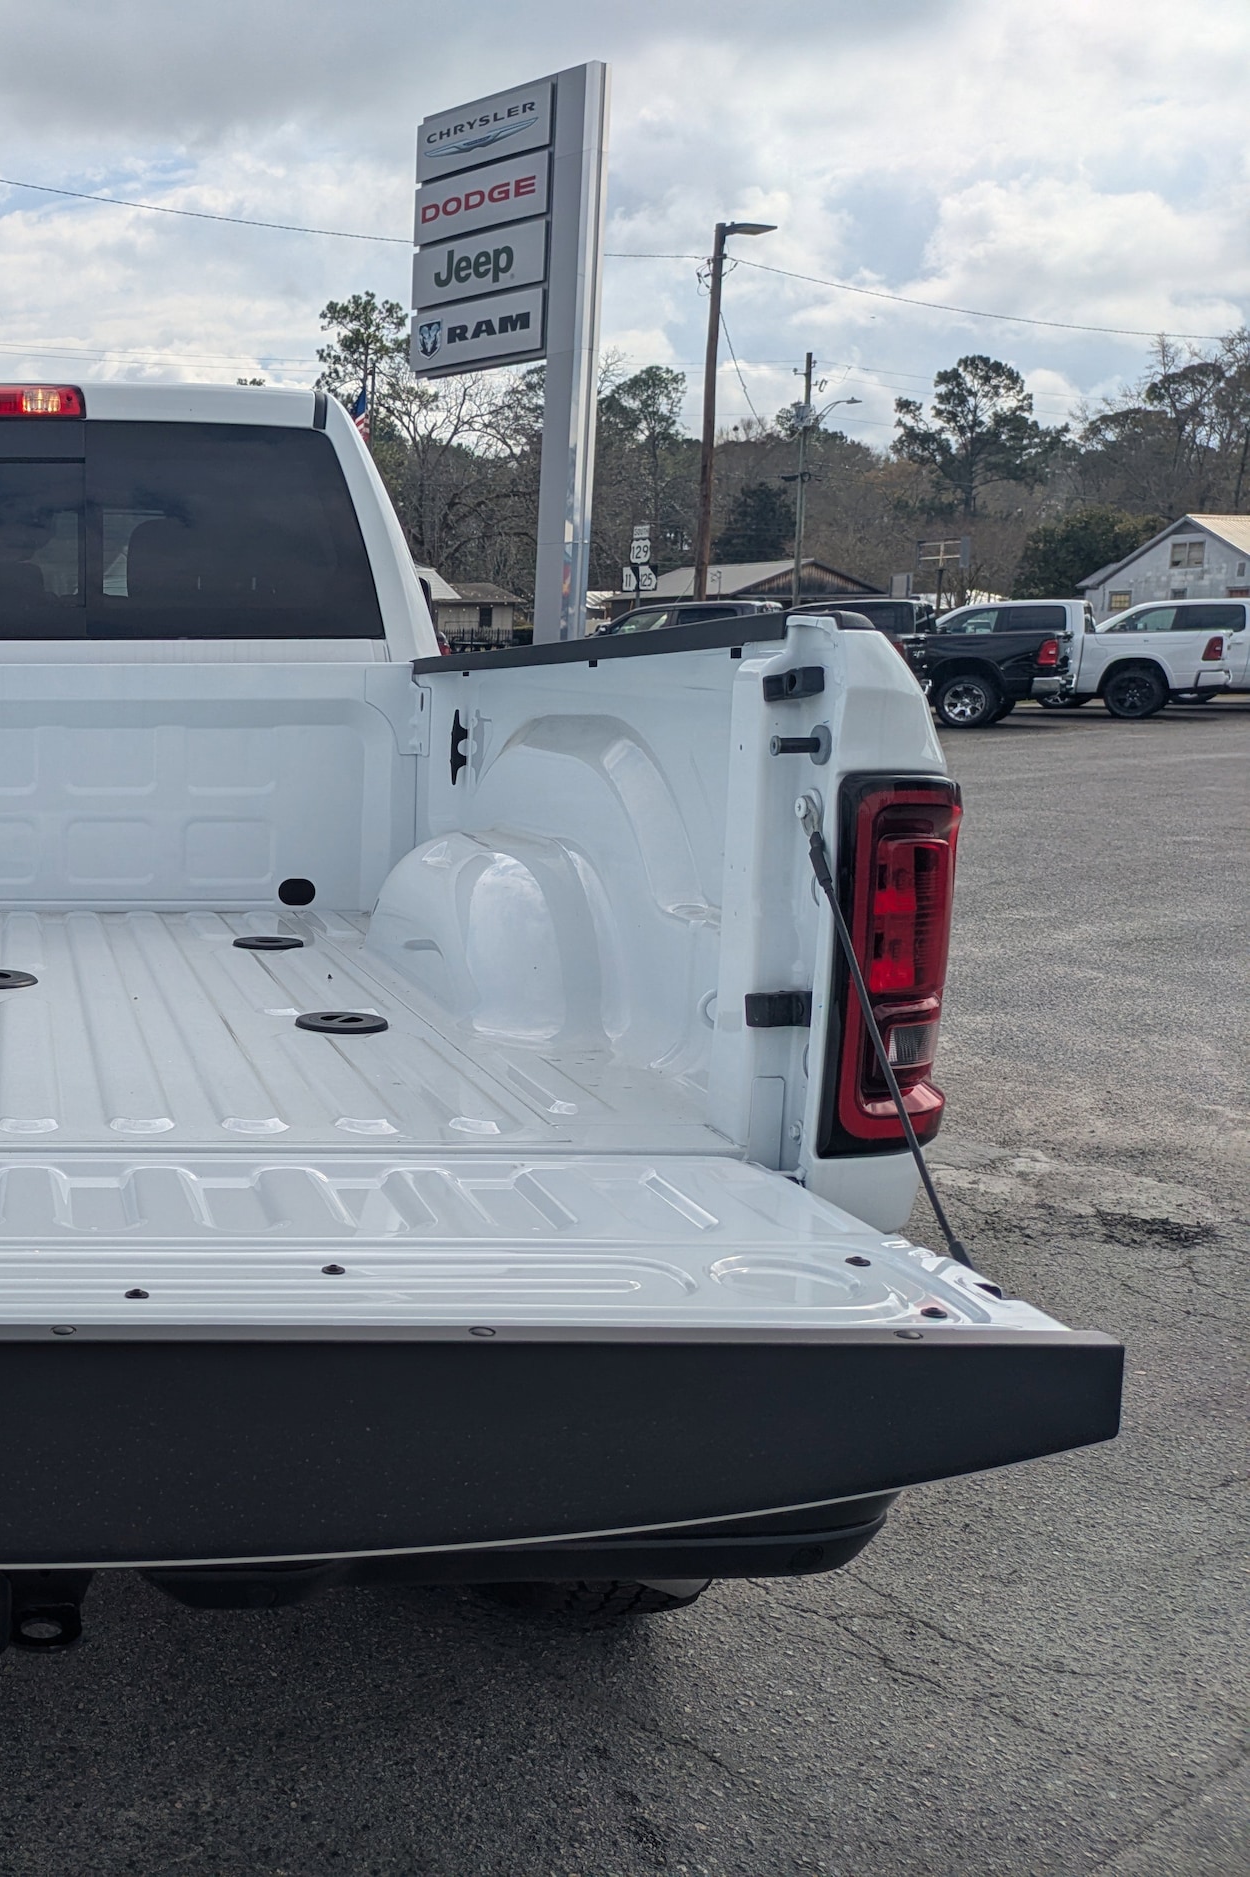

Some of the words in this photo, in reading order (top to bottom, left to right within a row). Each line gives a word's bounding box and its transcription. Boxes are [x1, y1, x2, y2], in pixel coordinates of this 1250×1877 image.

[426, 101, 536, 144] CHRYSLER
[421, 174, 537, 224] DODGE
[433, 245, 514, 288] Jeep
[447, 311, 531, 345] RAM
[631, 545, 649, 559] 129
[625, 573, 632, 587] 11
[640, 573, 653, 587] 125
